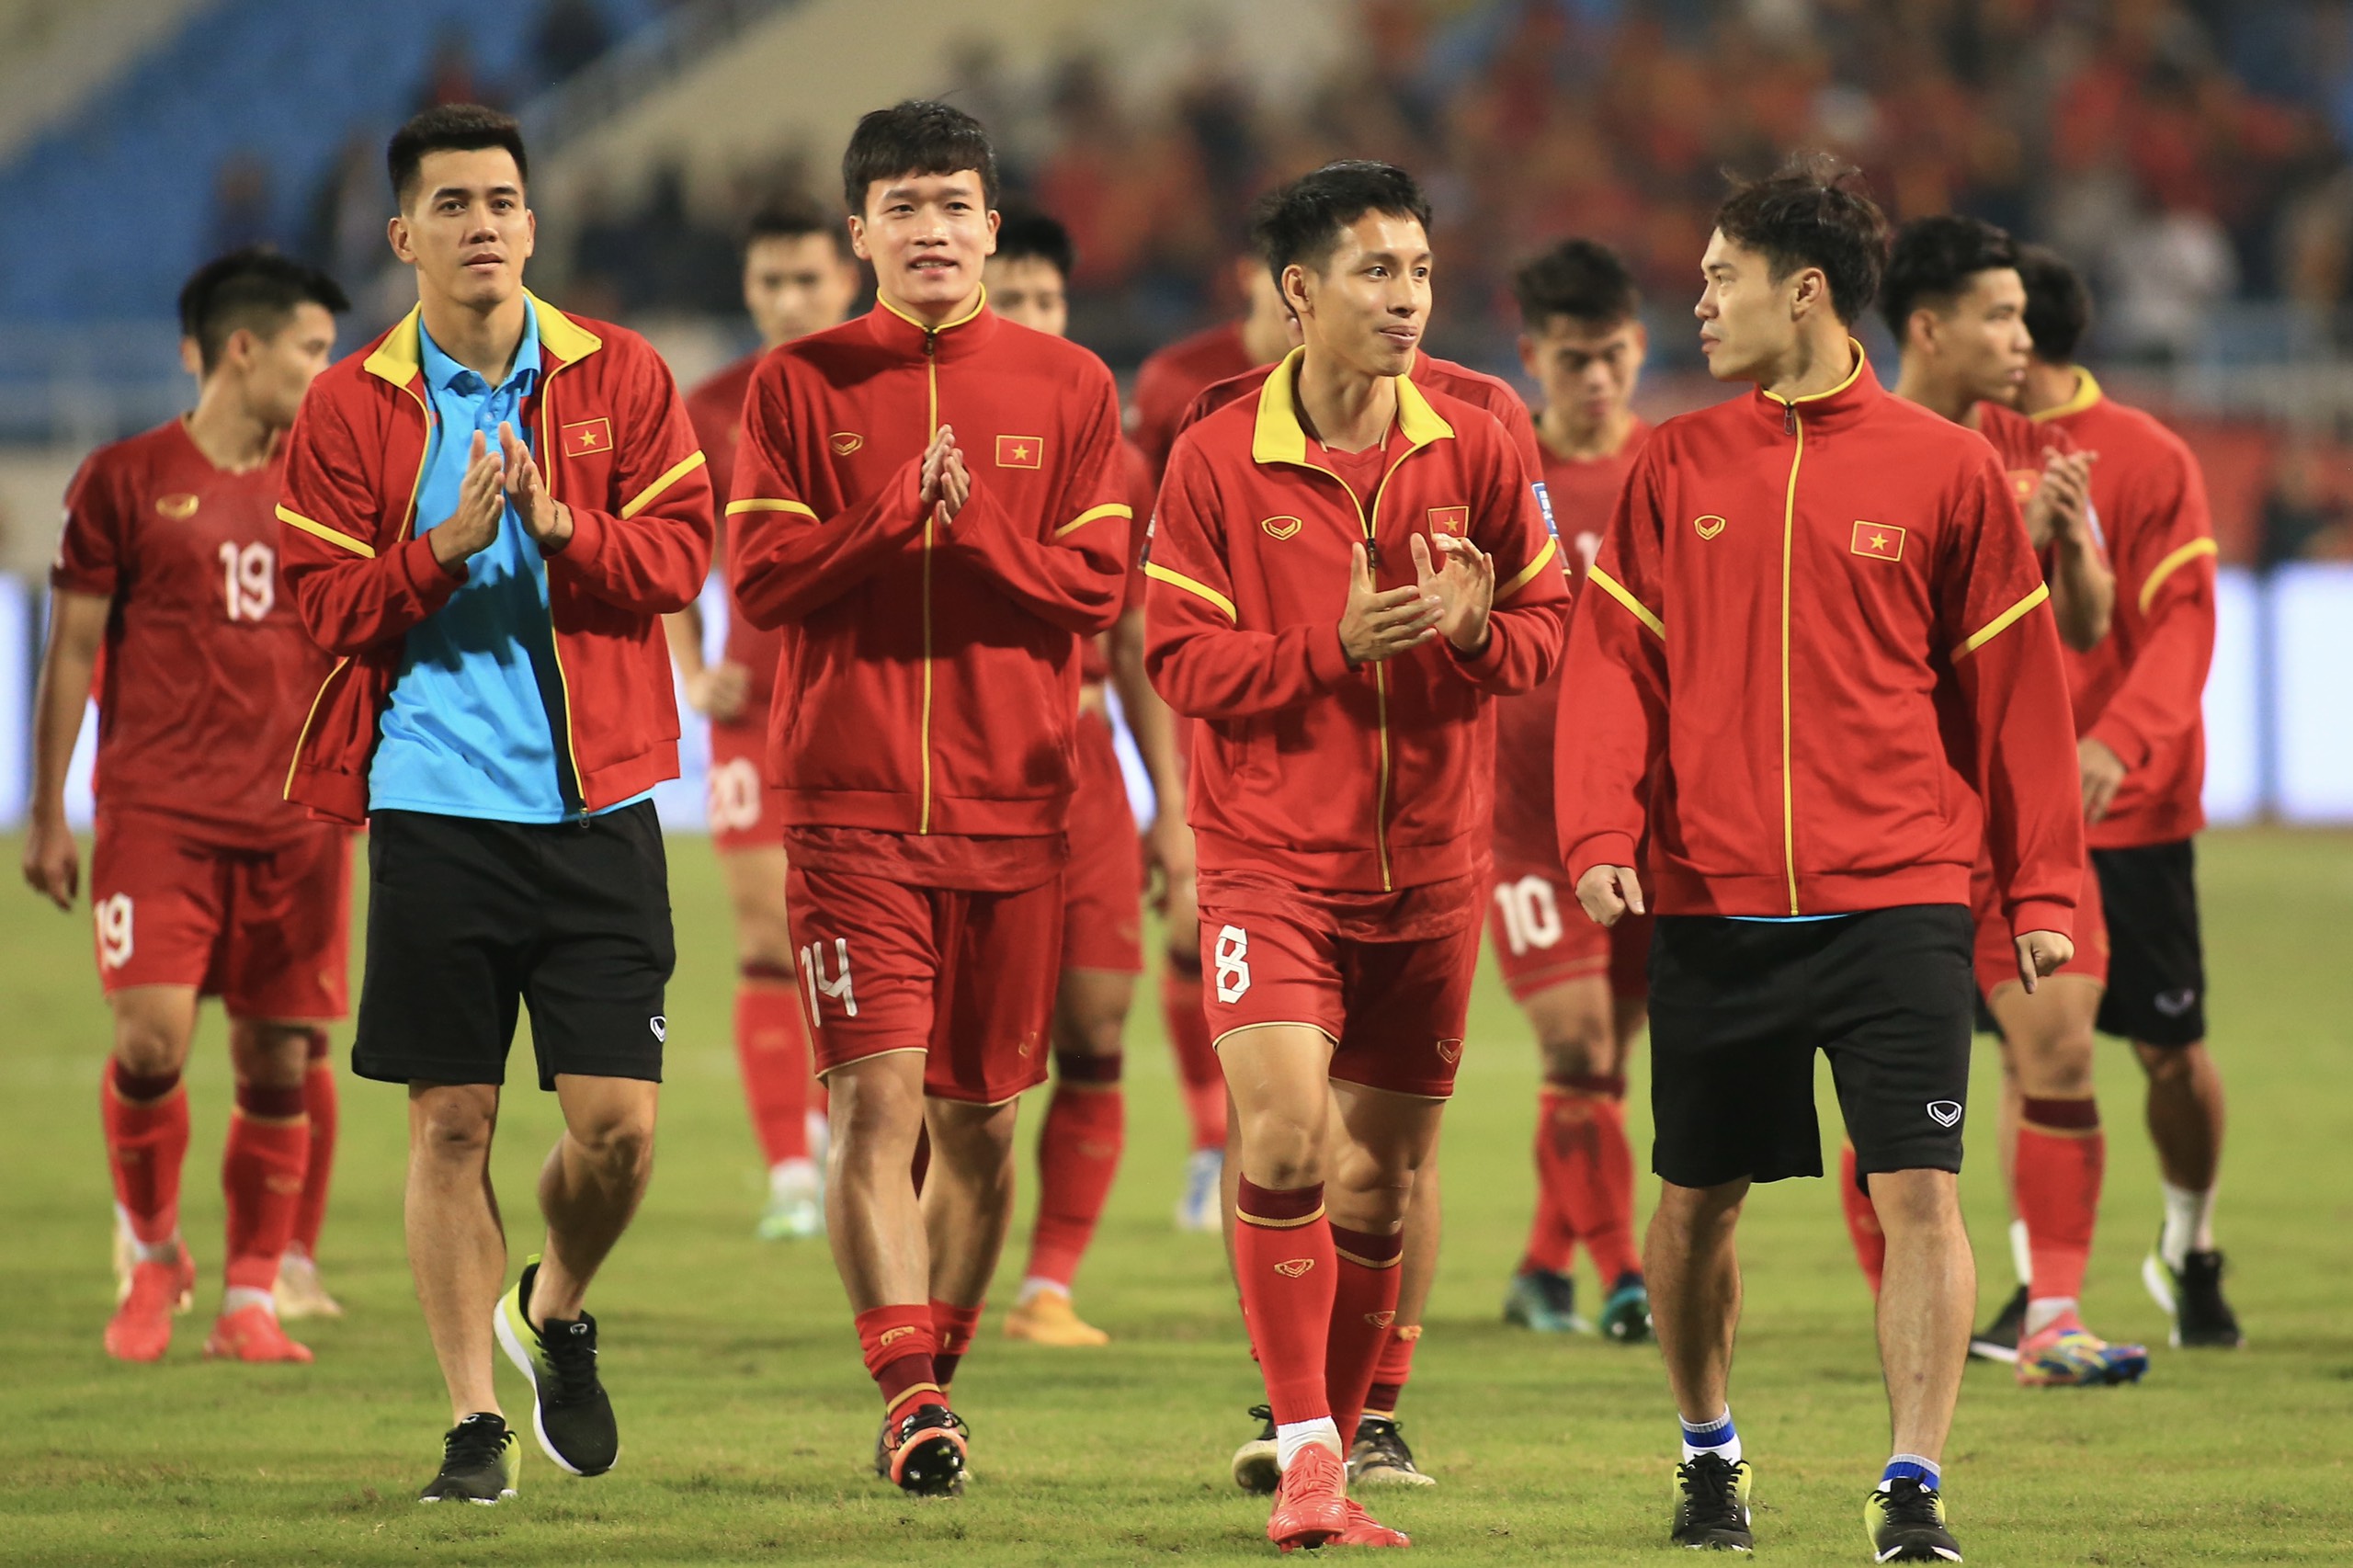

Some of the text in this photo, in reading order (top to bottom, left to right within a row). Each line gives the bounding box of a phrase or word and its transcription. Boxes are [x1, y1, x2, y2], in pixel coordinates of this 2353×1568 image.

[219, 540, 274, 621] 19
[93, 892, 133, 971] 19
[1494, 874, 1563, 956] 10
[800, 937, 858, 1028] 14
[1215, 924, 1251, 1004] 8
